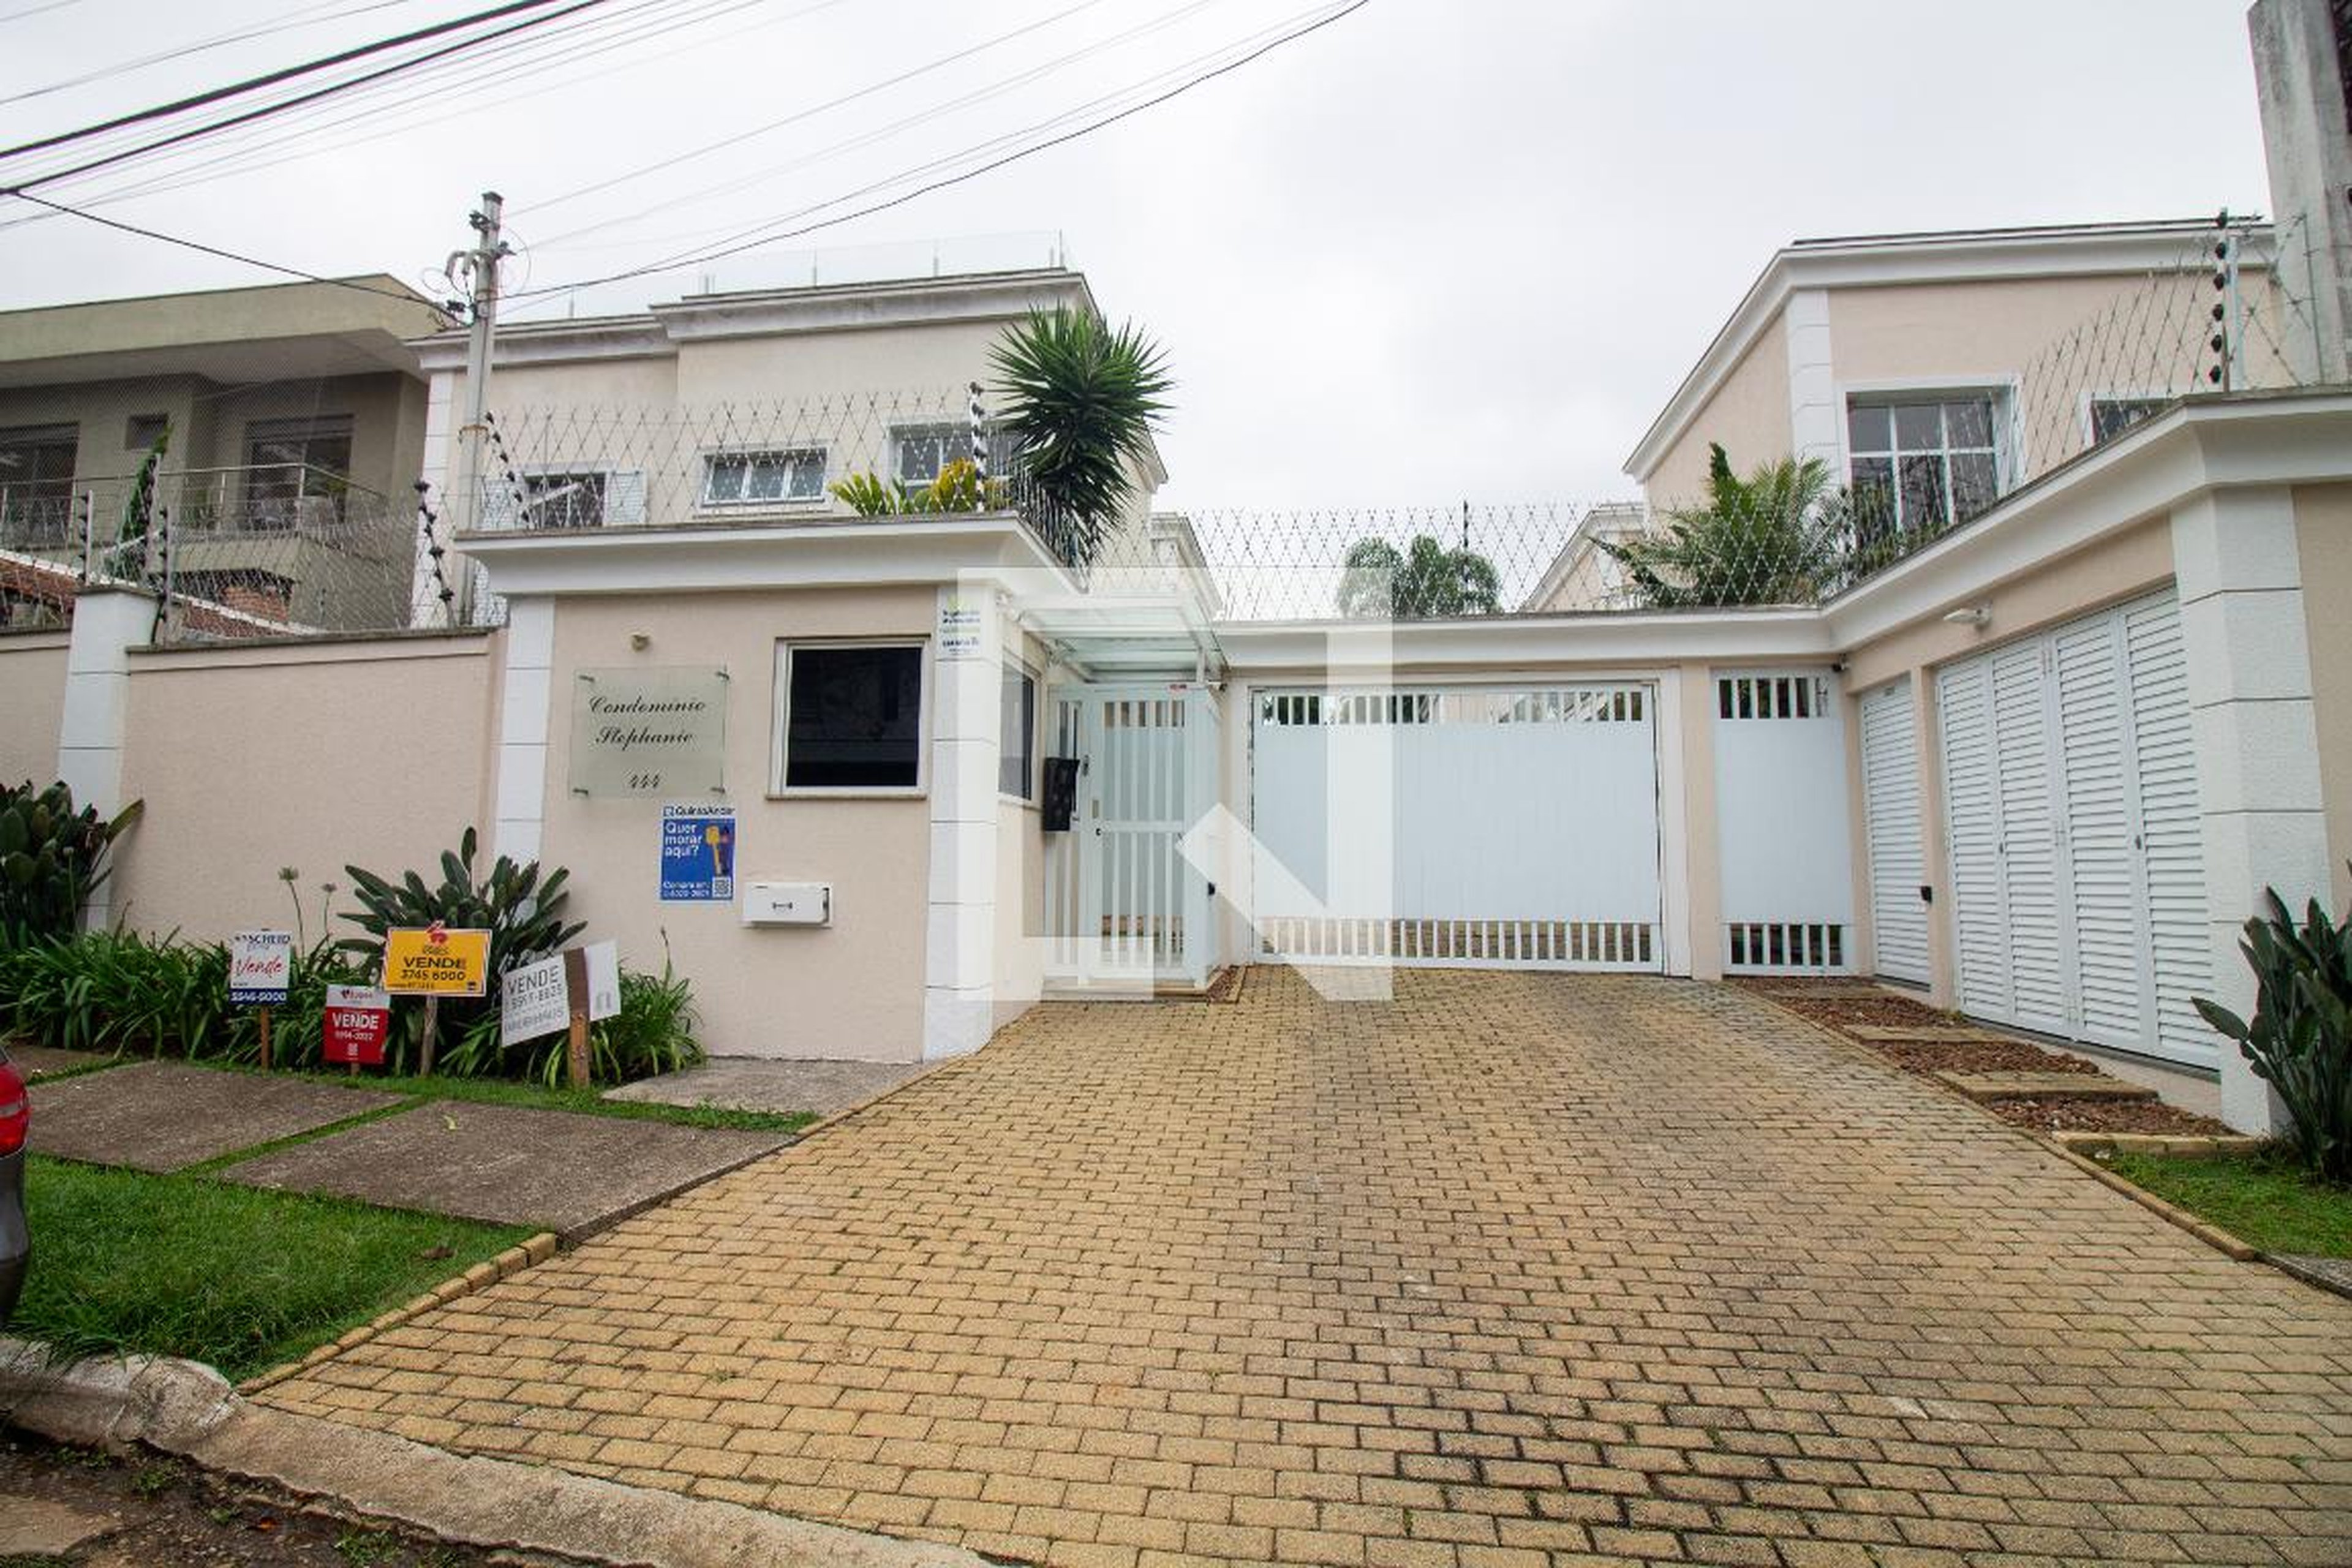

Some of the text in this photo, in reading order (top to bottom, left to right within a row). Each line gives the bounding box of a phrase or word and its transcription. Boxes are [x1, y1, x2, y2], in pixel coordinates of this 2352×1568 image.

[666, 821, 697, 834] Quer
[665, 835, 703, 845] morar
[236, 955, 282, 979] Vende
[404, 956, 466, 969] VENDE
[507, 965, 559, 995] VENDE
[332, 1012, 380, 1030] VENDE
